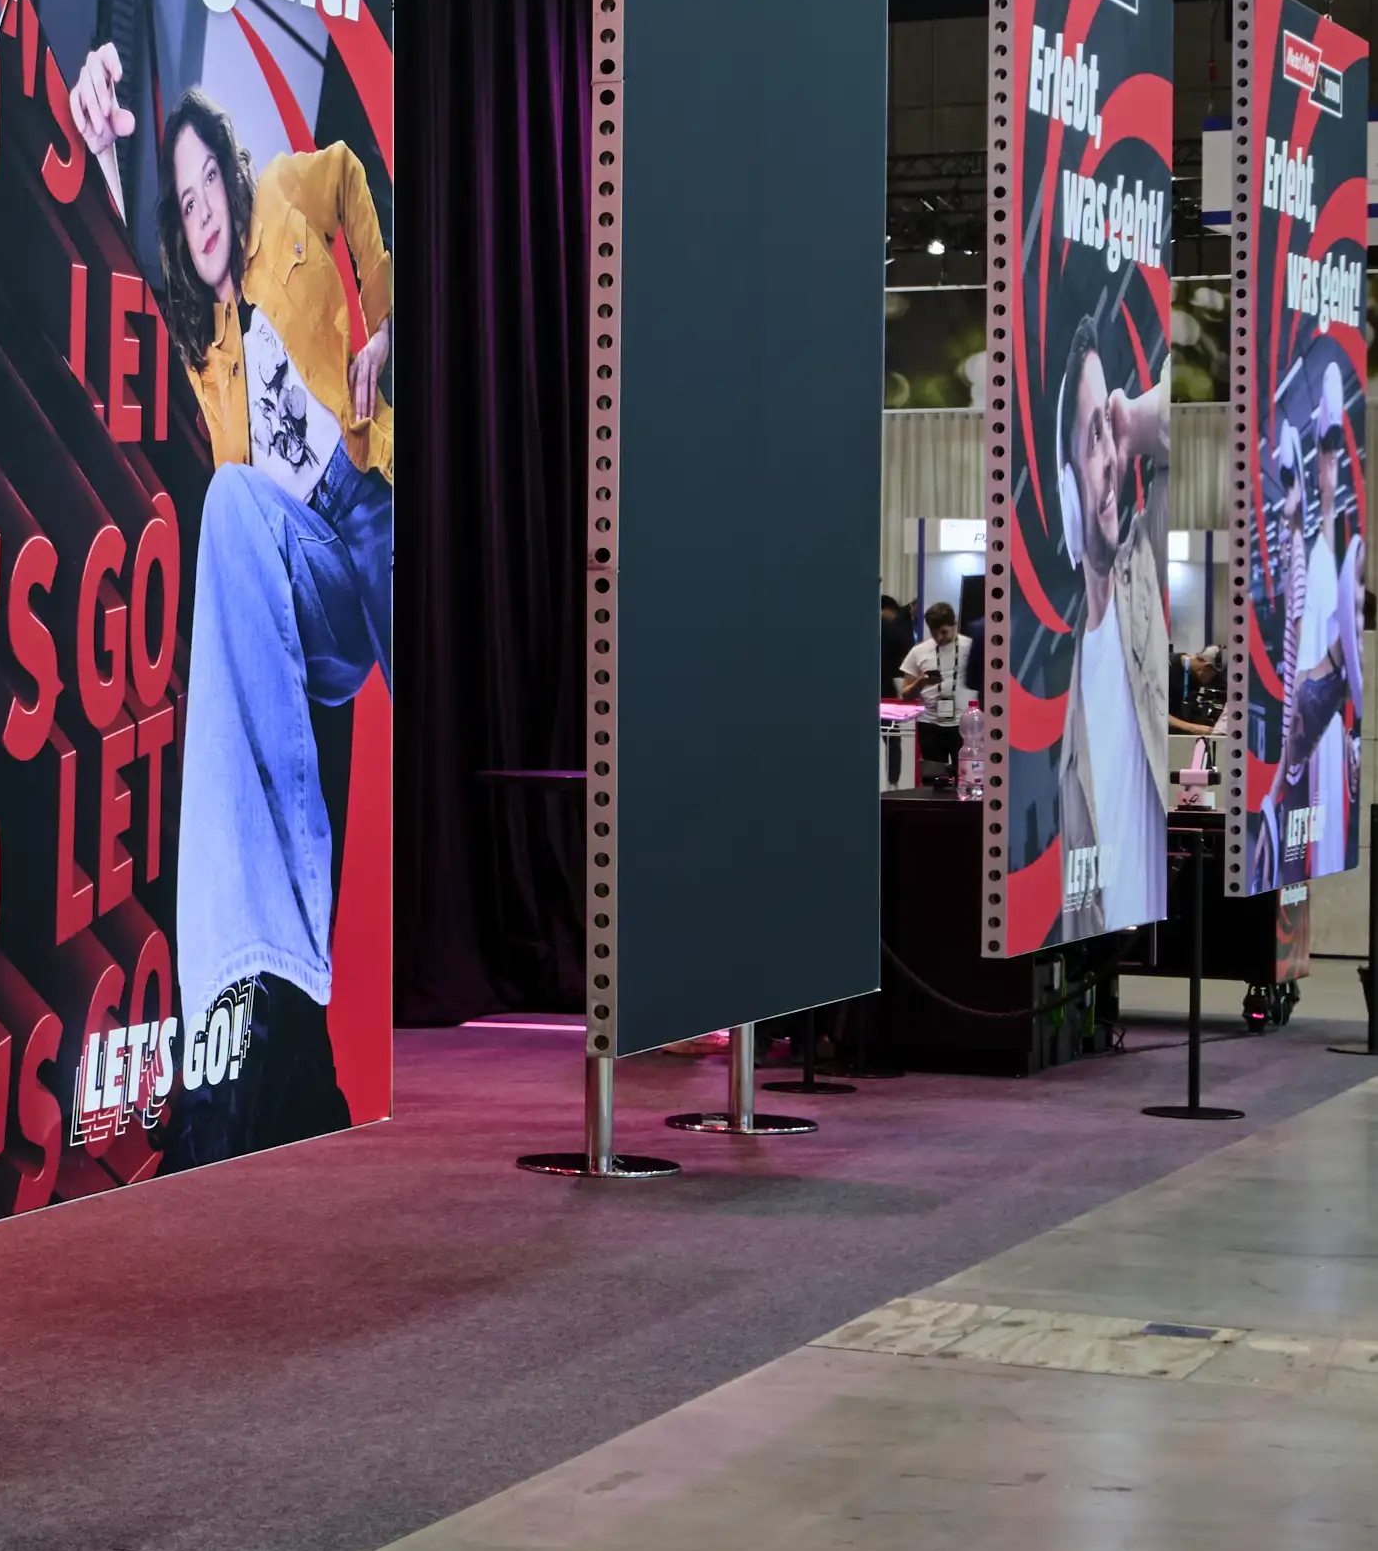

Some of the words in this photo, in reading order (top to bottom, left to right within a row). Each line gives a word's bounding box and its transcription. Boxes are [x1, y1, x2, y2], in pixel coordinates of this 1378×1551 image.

[1028, 23, 1103, 150] Erlebt,
[1062, 168, 1107, 251] was
[1106, 173, 1165, 273] geht!
[1262, 135, 1317, 234] Erlebt,
[1286, 250, 1320, 317] was
[1318, 250, 1363, 334] geht!
[82, 1015, 179, 1114] LET'S
[182, 1001, 247, 1092] GO!
